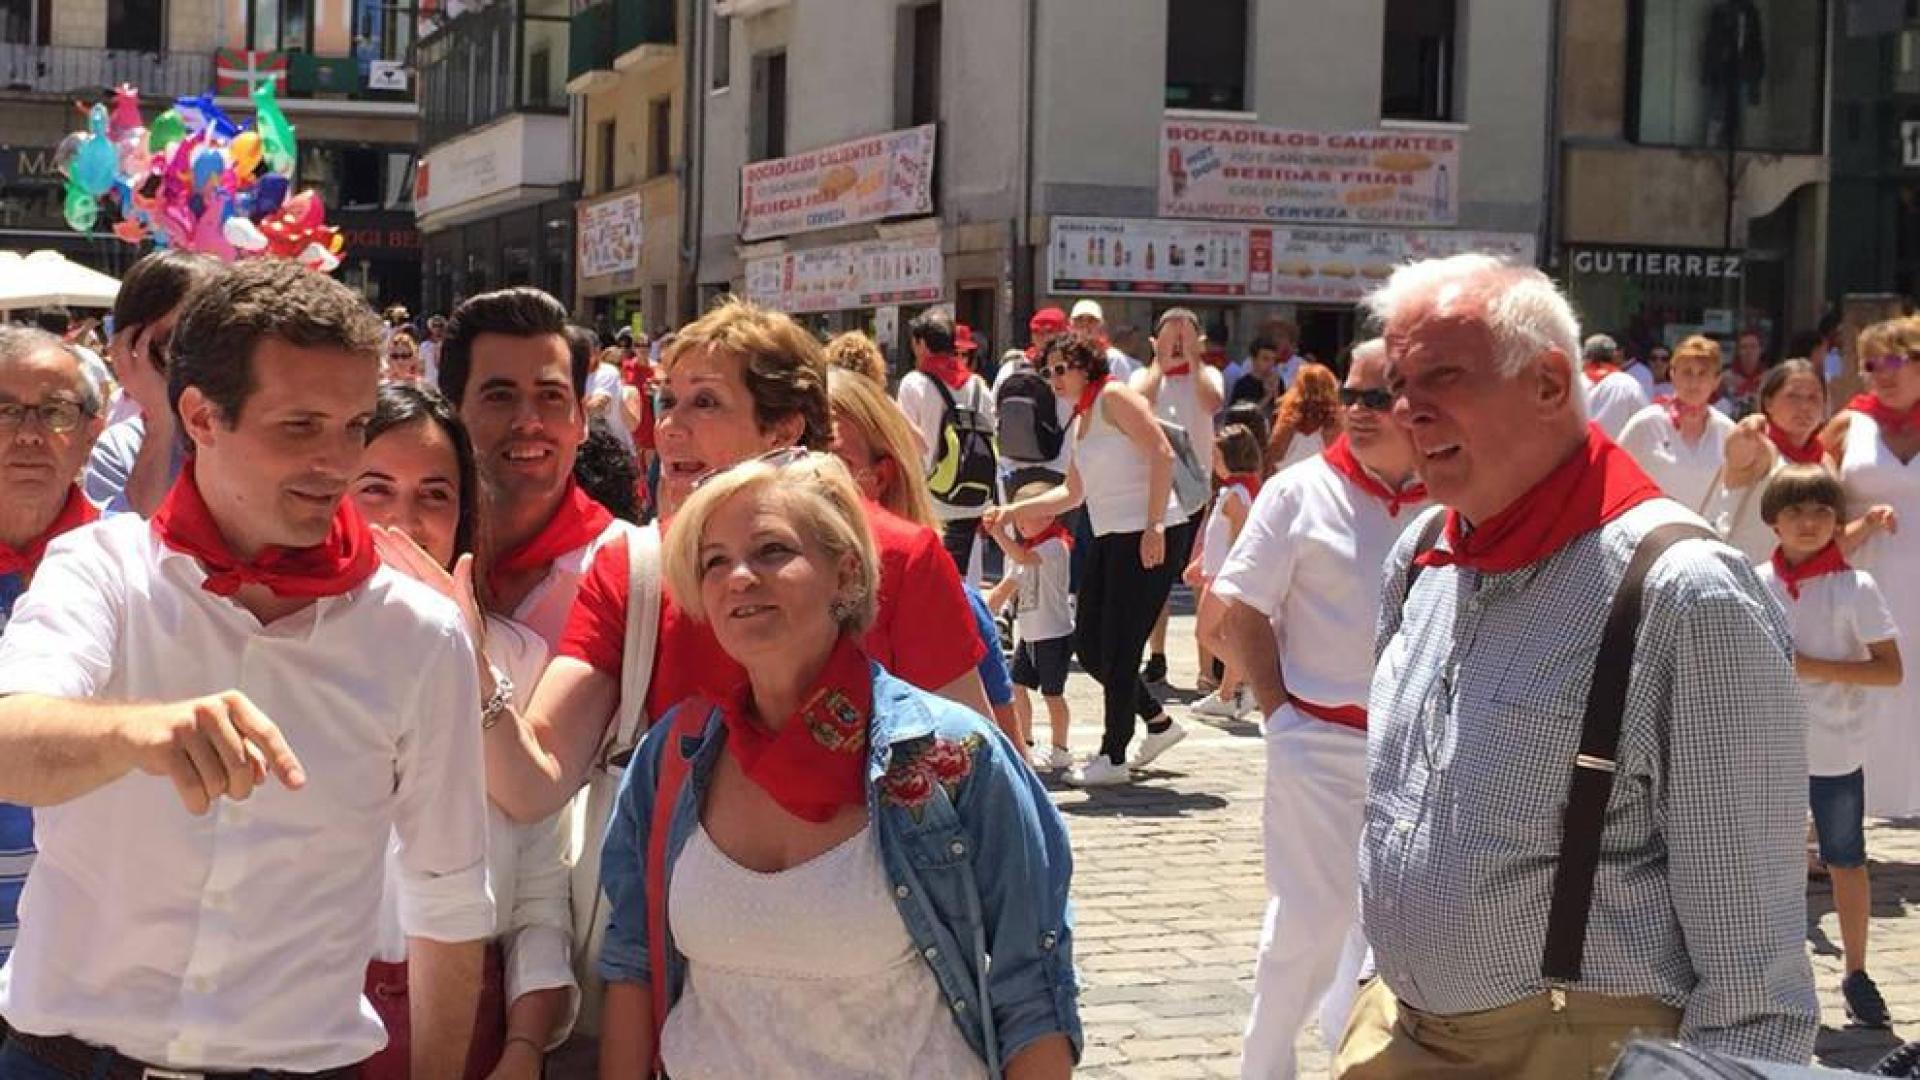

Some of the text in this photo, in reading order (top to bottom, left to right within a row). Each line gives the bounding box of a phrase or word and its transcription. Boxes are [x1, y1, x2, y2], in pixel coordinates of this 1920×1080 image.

[820, 138, 882, 166] CALIENTES
[1167, 126, 1456, 152] BOCADILLOS CALIENTES
[1223, 168, 1415, 186] BEBIDAS FRIAS
[1265, 206, 1348, 219] CERVEZA
[1573, 251, 1742, 278] GUTIERREZ
